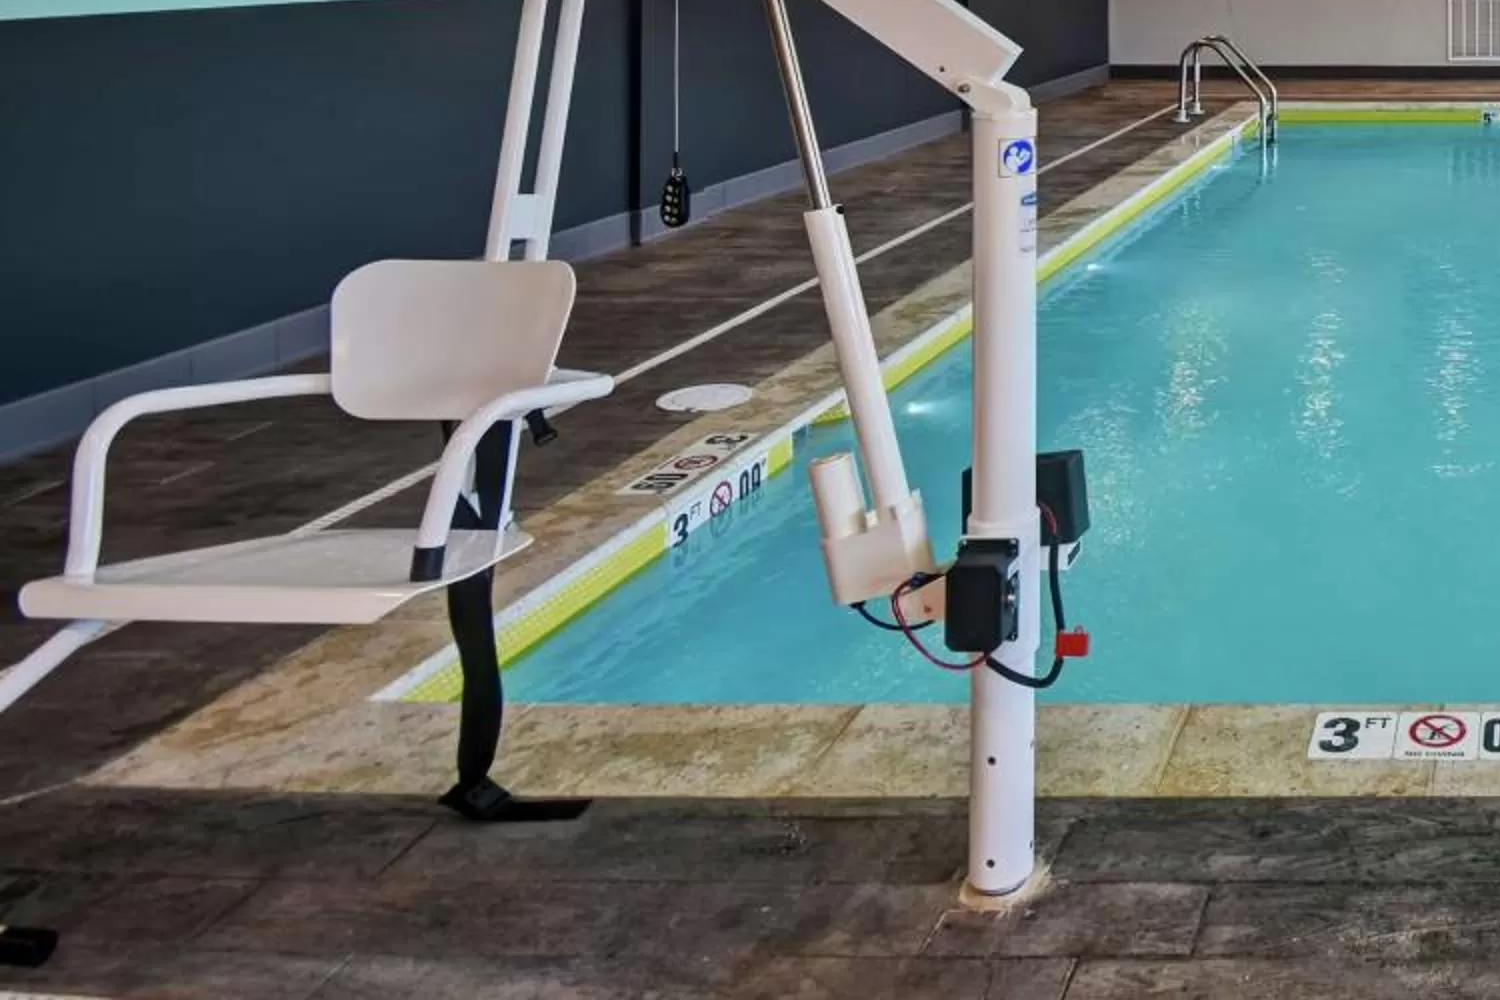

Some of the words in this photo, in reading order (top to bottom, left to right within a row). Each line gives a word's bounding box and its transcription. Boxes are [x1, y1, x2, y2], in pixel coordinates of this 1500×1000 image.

[673, 513, 689, 548] 3
[1319, 717, 1361, 753] 3
[1365, 717, 1391, 729] FT
